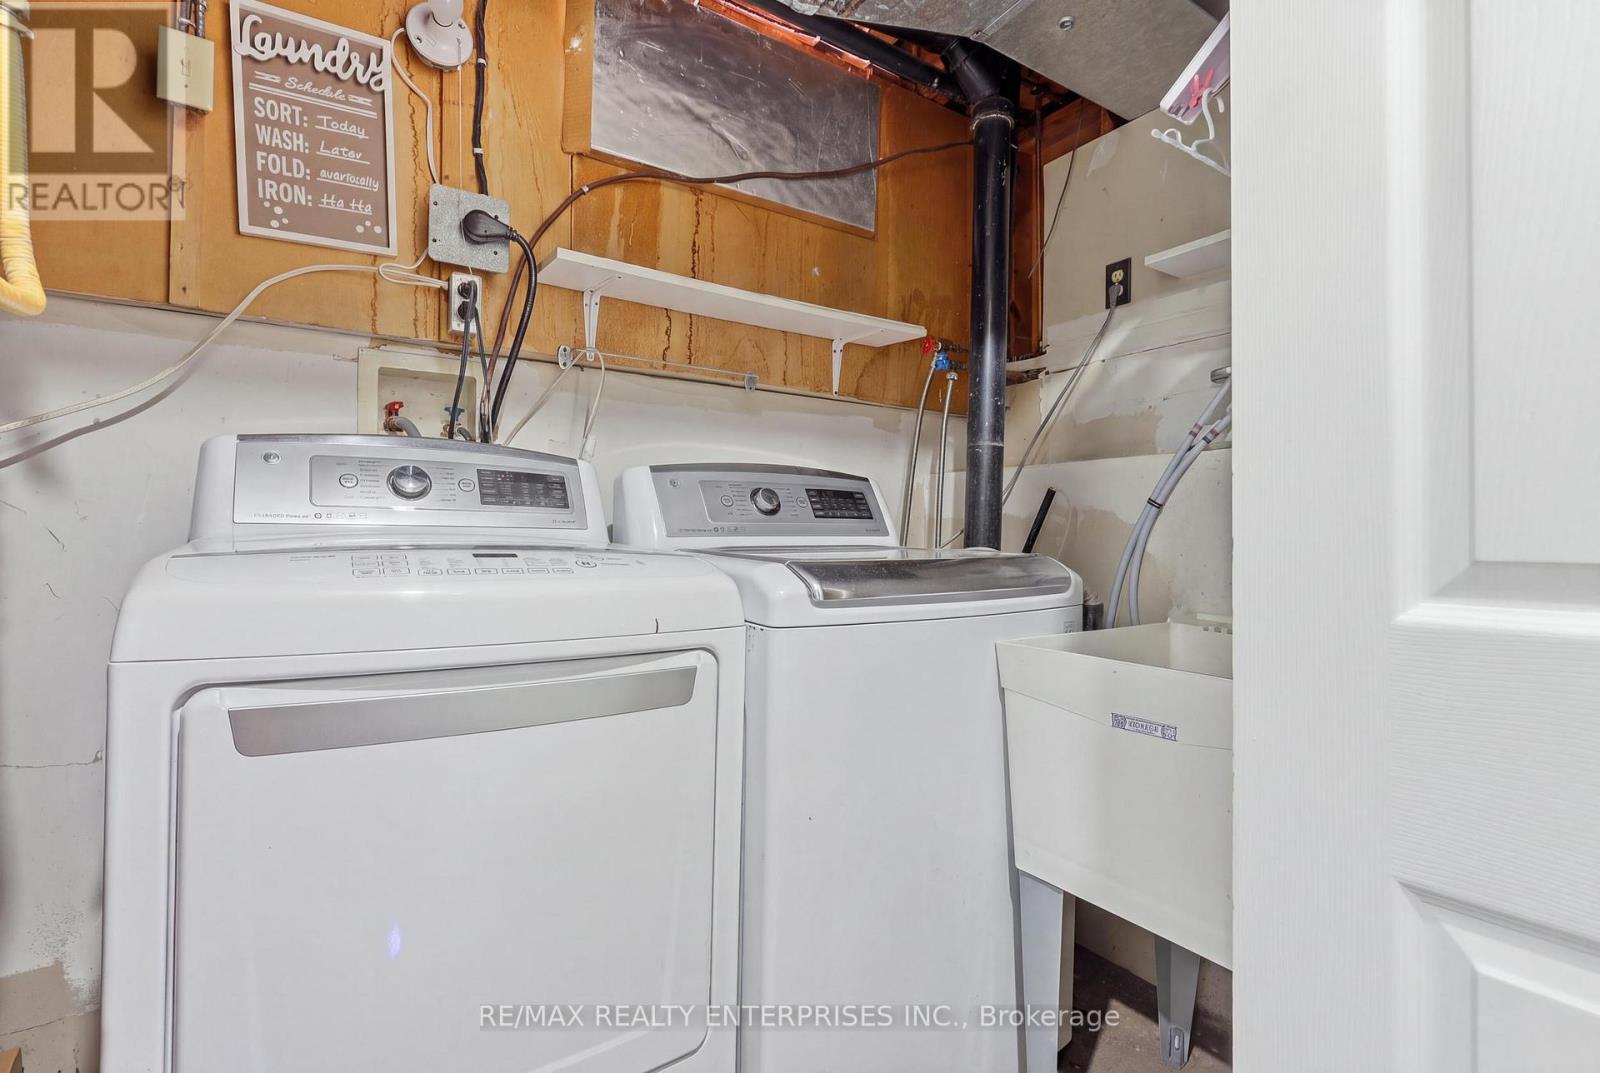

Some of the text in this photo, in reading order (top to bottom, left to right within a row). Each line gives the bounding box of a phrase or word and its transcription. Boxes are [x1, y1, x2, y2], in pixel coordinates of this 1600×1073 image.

[233, 14, 388, 92] Laundry
[284, 76, 347, 102] Schedule
[254, 97, 367, 138] SORT: Today
[255, 123, 309, 154] WASH:
[256, 150, 311, 180] FOLD:
[258, 178, 312, 206] IRON:
